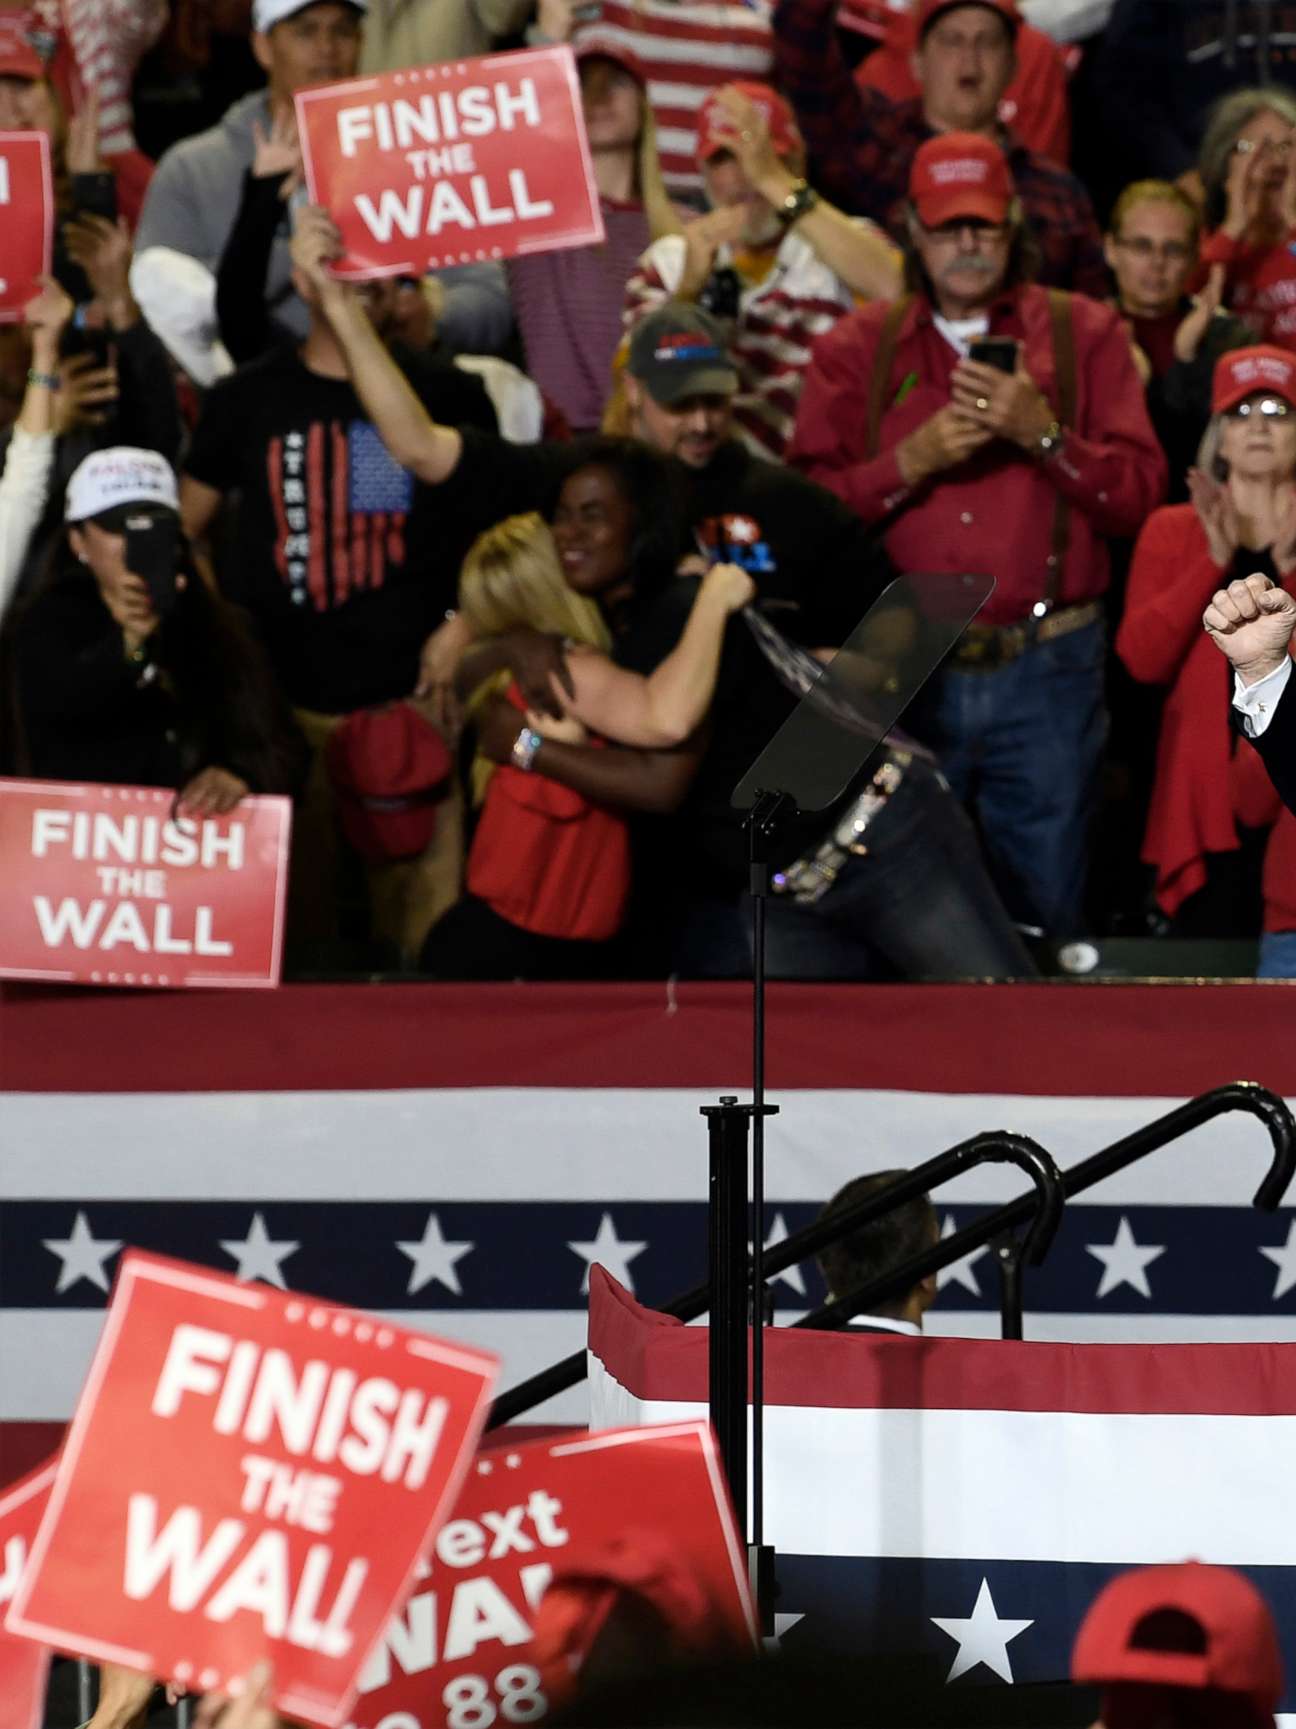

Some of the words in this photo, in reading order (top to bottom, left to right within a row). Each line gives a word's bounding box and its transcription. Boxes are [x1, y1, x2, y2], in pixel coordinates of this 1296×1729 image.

[337, 78, 541, 157] FINISH
[406, 143, 475, 180] THE
[354, 169, 554, 243] WALL
[31, 808, 245, 870] FINISH
[97, 866, 167, 899] THE
[33, 896, 233, 957] WALL
[151, 1323, 450, 1492] FINISH
[241, 1453, 344, 1535] THE
[415, 1489, 569, 1580] ext
[123, 1492, 369, 1659] WALL
